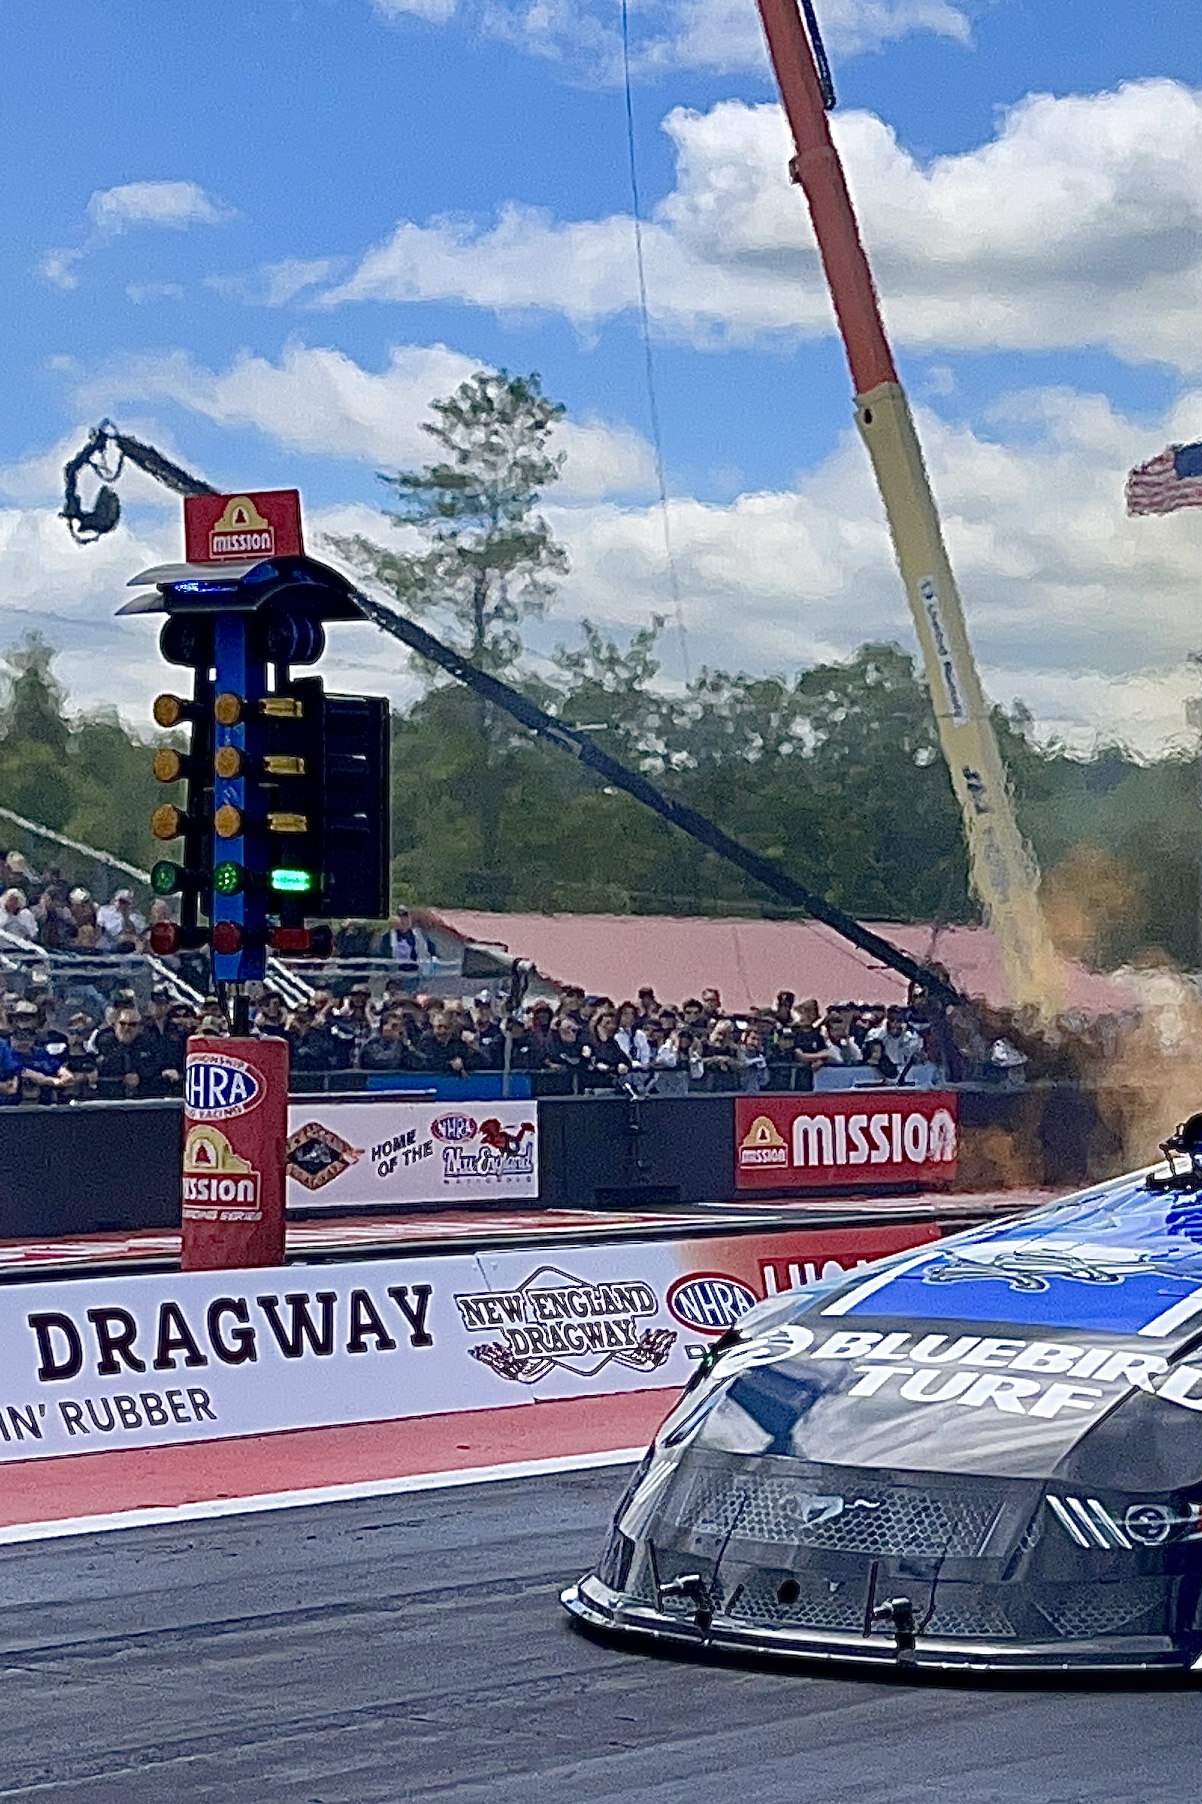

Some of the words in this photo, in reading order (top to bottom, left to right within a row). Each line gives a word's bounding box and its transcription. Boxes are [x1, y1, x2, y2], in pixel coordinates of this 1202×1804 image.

[371, 1129, 417, 1162] HOME
[377, 1157, 398, 1177] OF
[403, 1140, 433, 1166] THE
[792, 1108, 957, 1168] MISSION
[460, 1294, 526, 1326] NEW
[530, 1285, 655, 1320] ENGLAND
[678, 1281, 749, 1325] NHRA
[28, 1284, 433, 1382] DRAGWAY
[507, 1318, 636, 1355] DRAGWAY
[59, 1387, 217, 1435] RUBBER
[848, 1366, 1103, 1418] TURF
